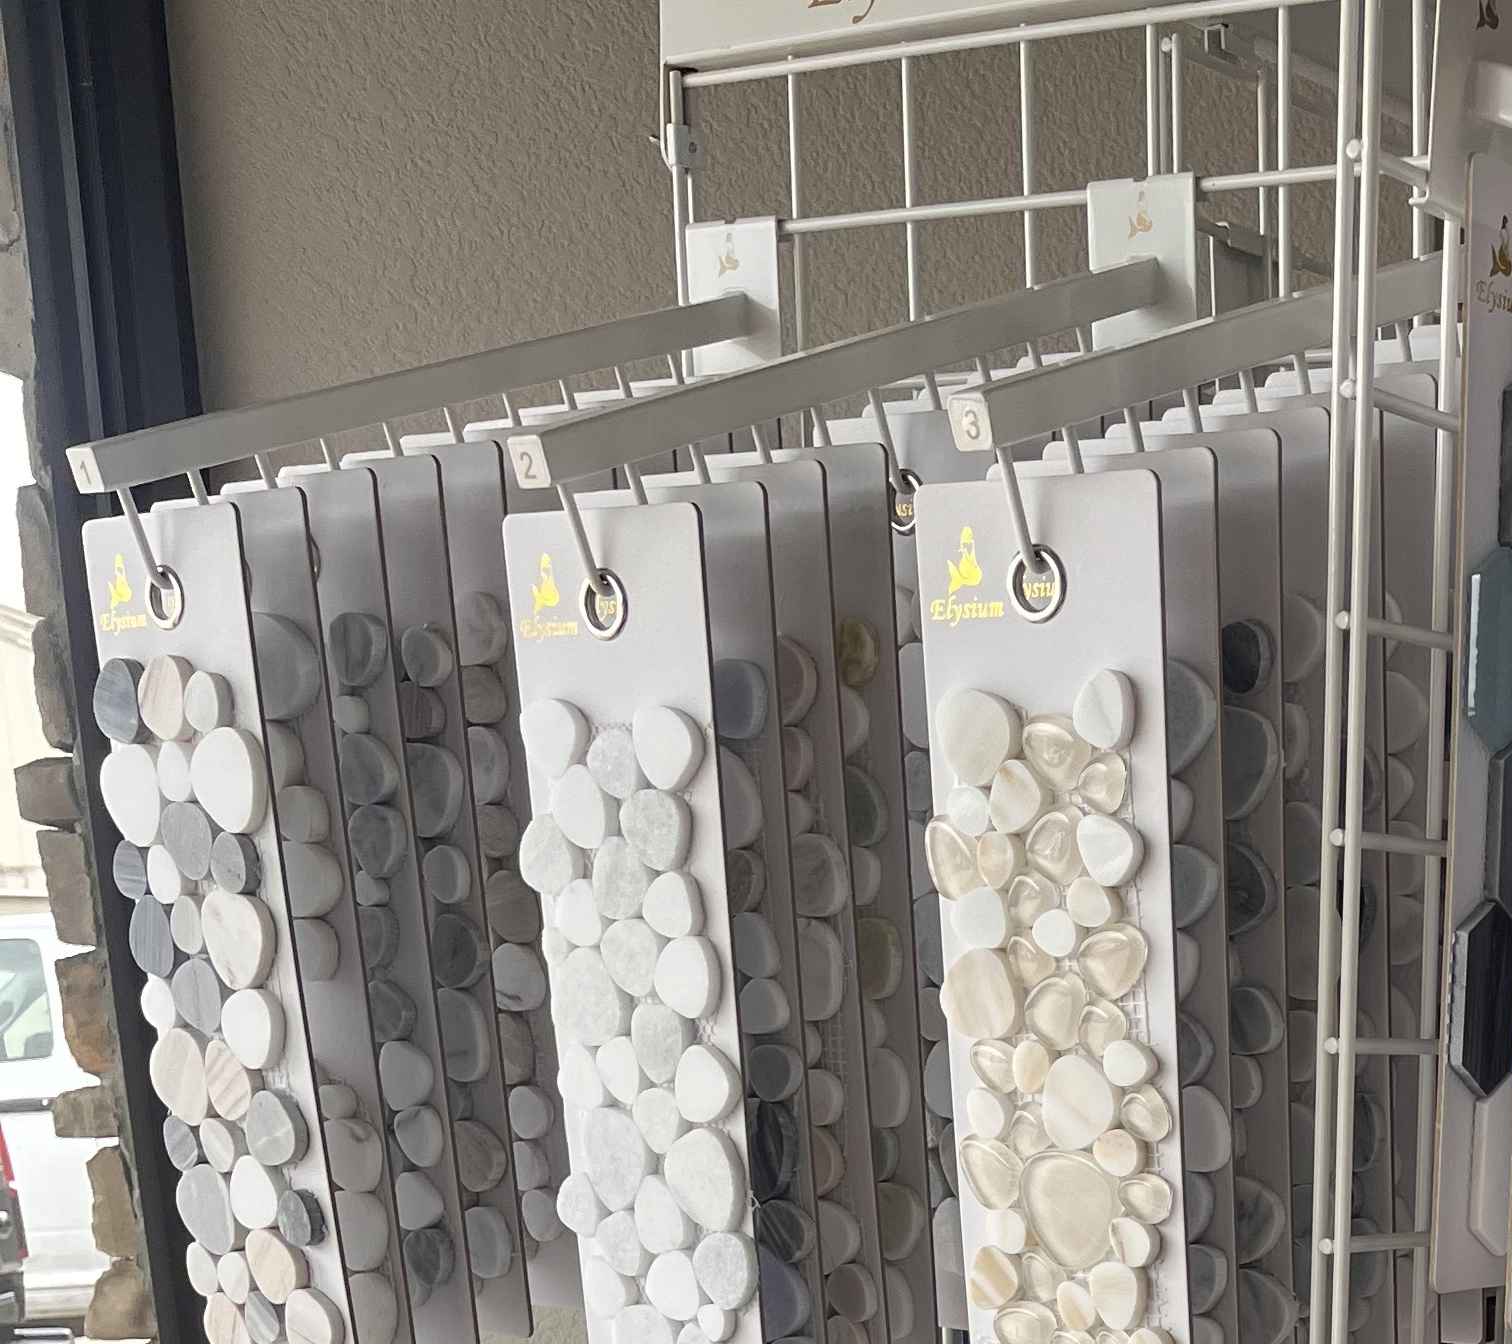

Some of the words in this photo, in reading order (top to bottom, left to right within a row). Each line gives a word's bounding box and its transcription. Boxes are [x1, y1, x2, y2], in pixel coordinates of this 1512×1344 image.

[963, 410, 980, 439] 3
[80, 460, 92, 486] 1
[520, 452, 536, 479] 2
[930, 595, 1004, 626] Elysium
